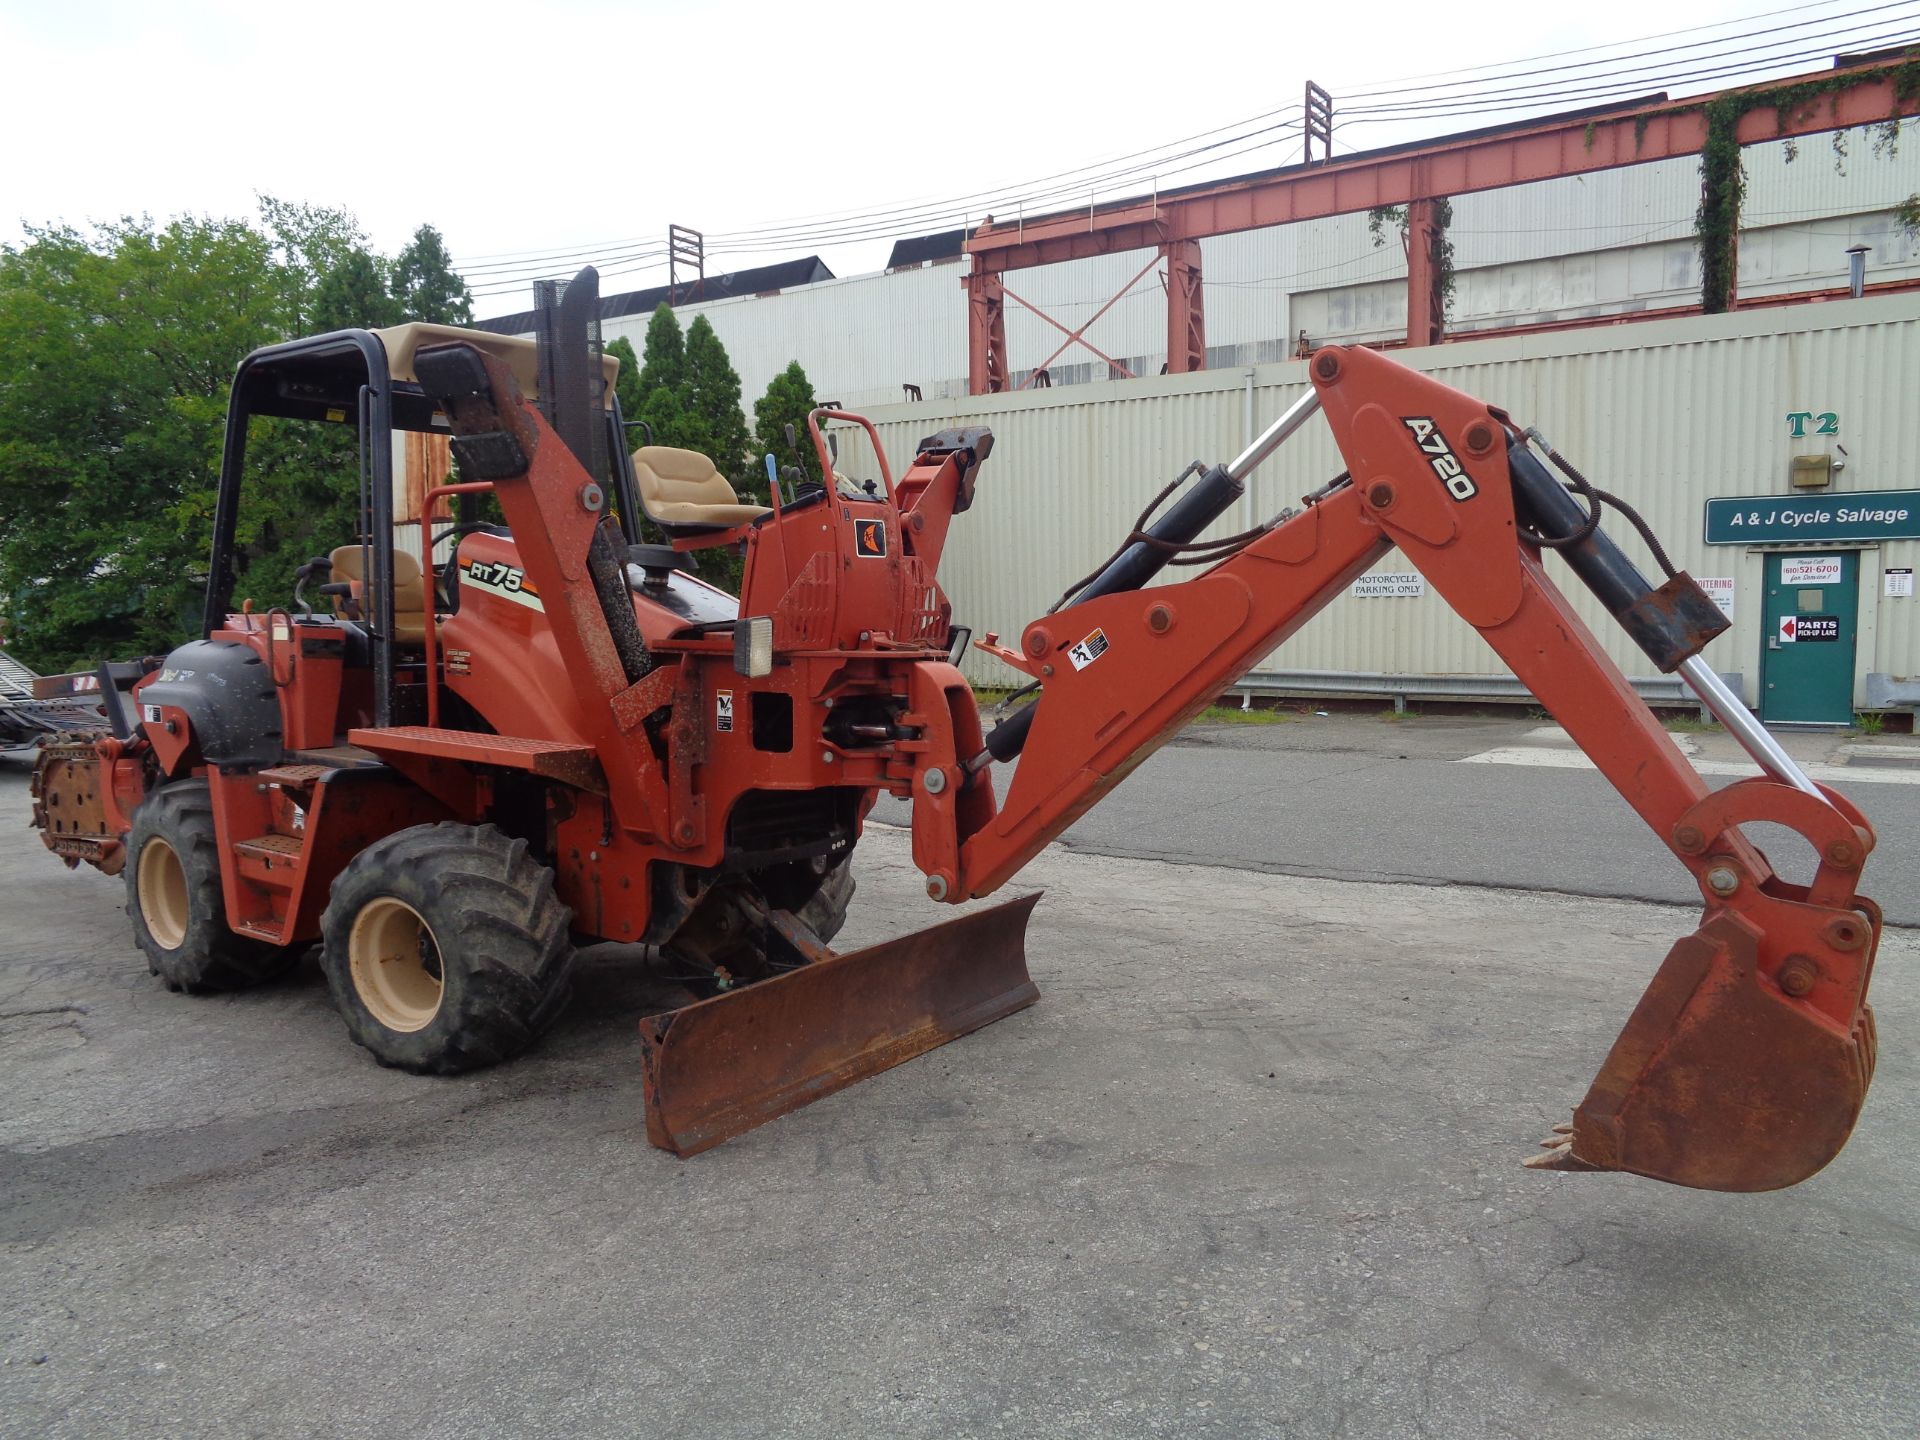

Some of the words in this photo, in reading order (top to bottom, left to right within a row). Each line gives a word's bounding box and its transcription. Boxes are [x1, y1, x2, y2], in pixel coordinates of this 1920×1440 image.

[1404, 419, 1475, 500] A720
[1730, 513, 1743, 526] A
[1748, 512, 1760, 525] &
[1765, 511, 1776, 525] J
[1780, 510, 1831, 527] Cycle
[1836, 508, 1908, 524] Salvage
[1358, 575, 1418, 584] MOTORCYCLE
[1355, 586, 1394, 594] PARKING
[1397, 585, 1421, 593] ONLY
[1797, 621, 1837, 629] PARTS
[1797, 629, 1820, 637] PICK-UP
